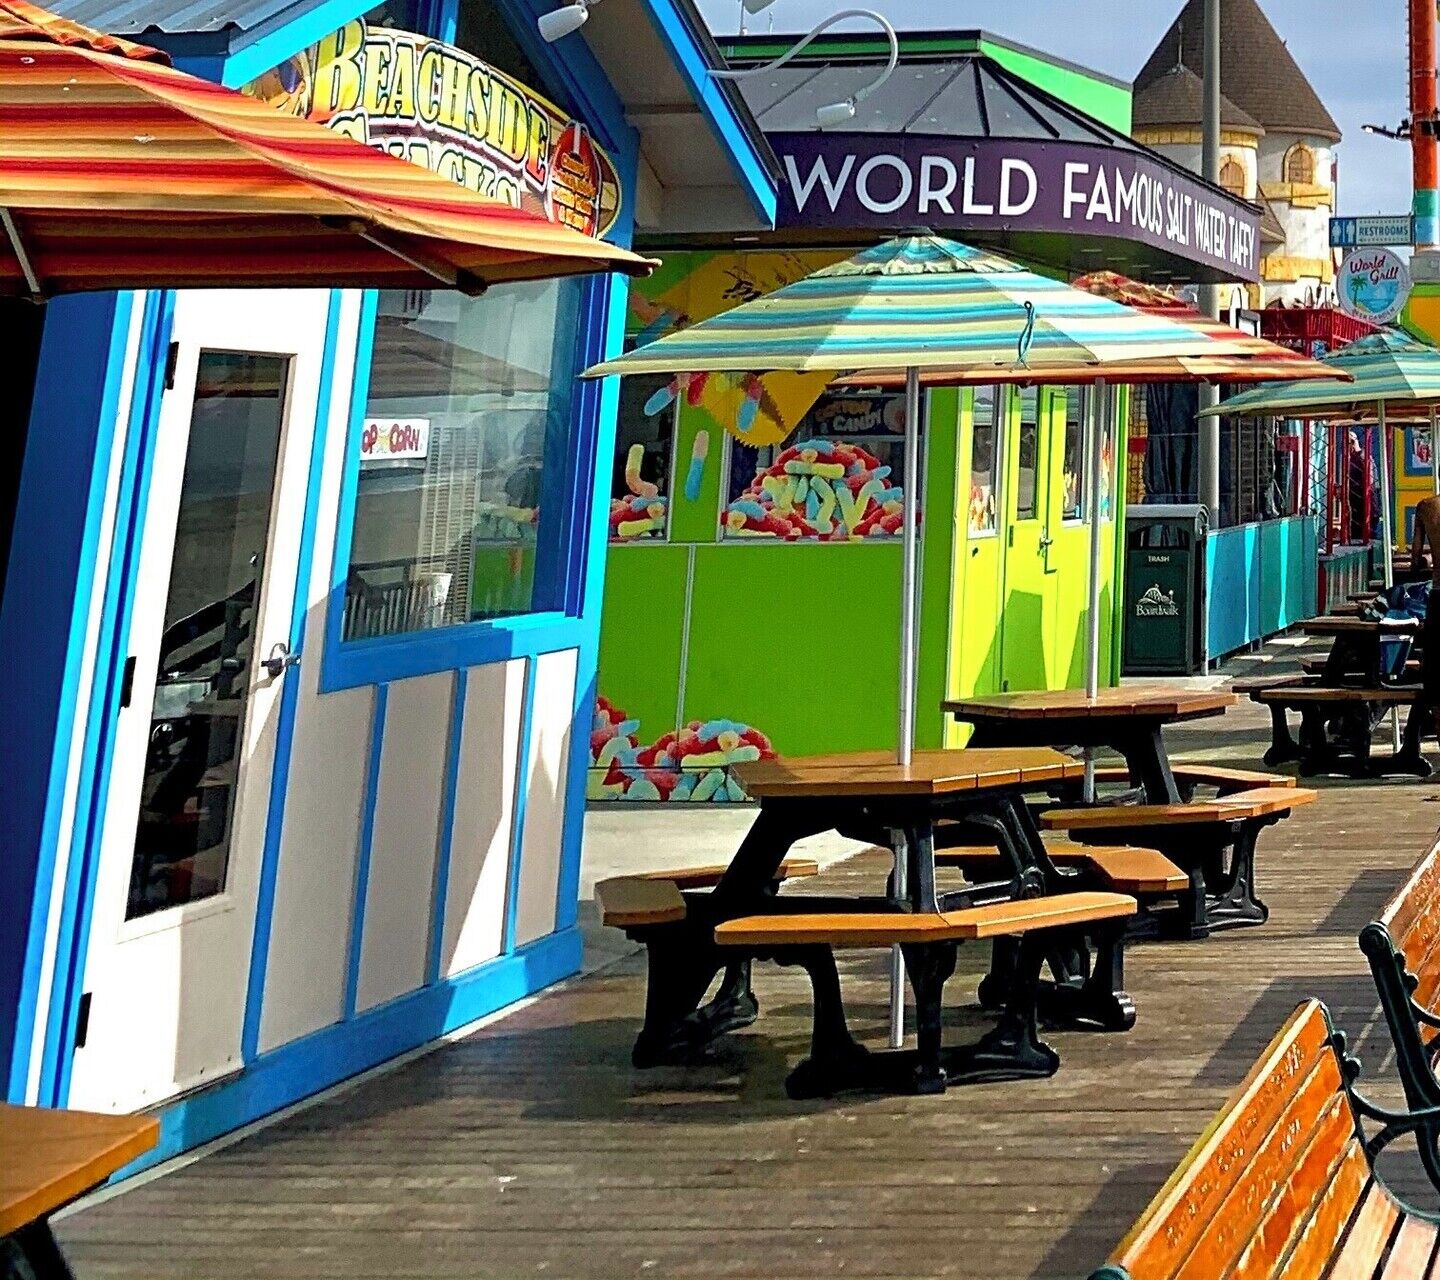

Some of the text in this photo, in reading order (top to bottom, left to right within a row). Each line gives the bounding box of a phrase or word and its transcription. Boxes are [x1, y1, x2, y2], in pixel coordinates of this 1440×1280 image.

[305, 17, 549, 187] BEACHSIDE
[783, 154, 1255, 271] WORLD FAMOUS SALT WATER TAFFY
[1358, 225, 1408, 237] RESTROOMS
[1350, 255, 1386, 274] World
[1370, 266, 1399, 285] Grill
